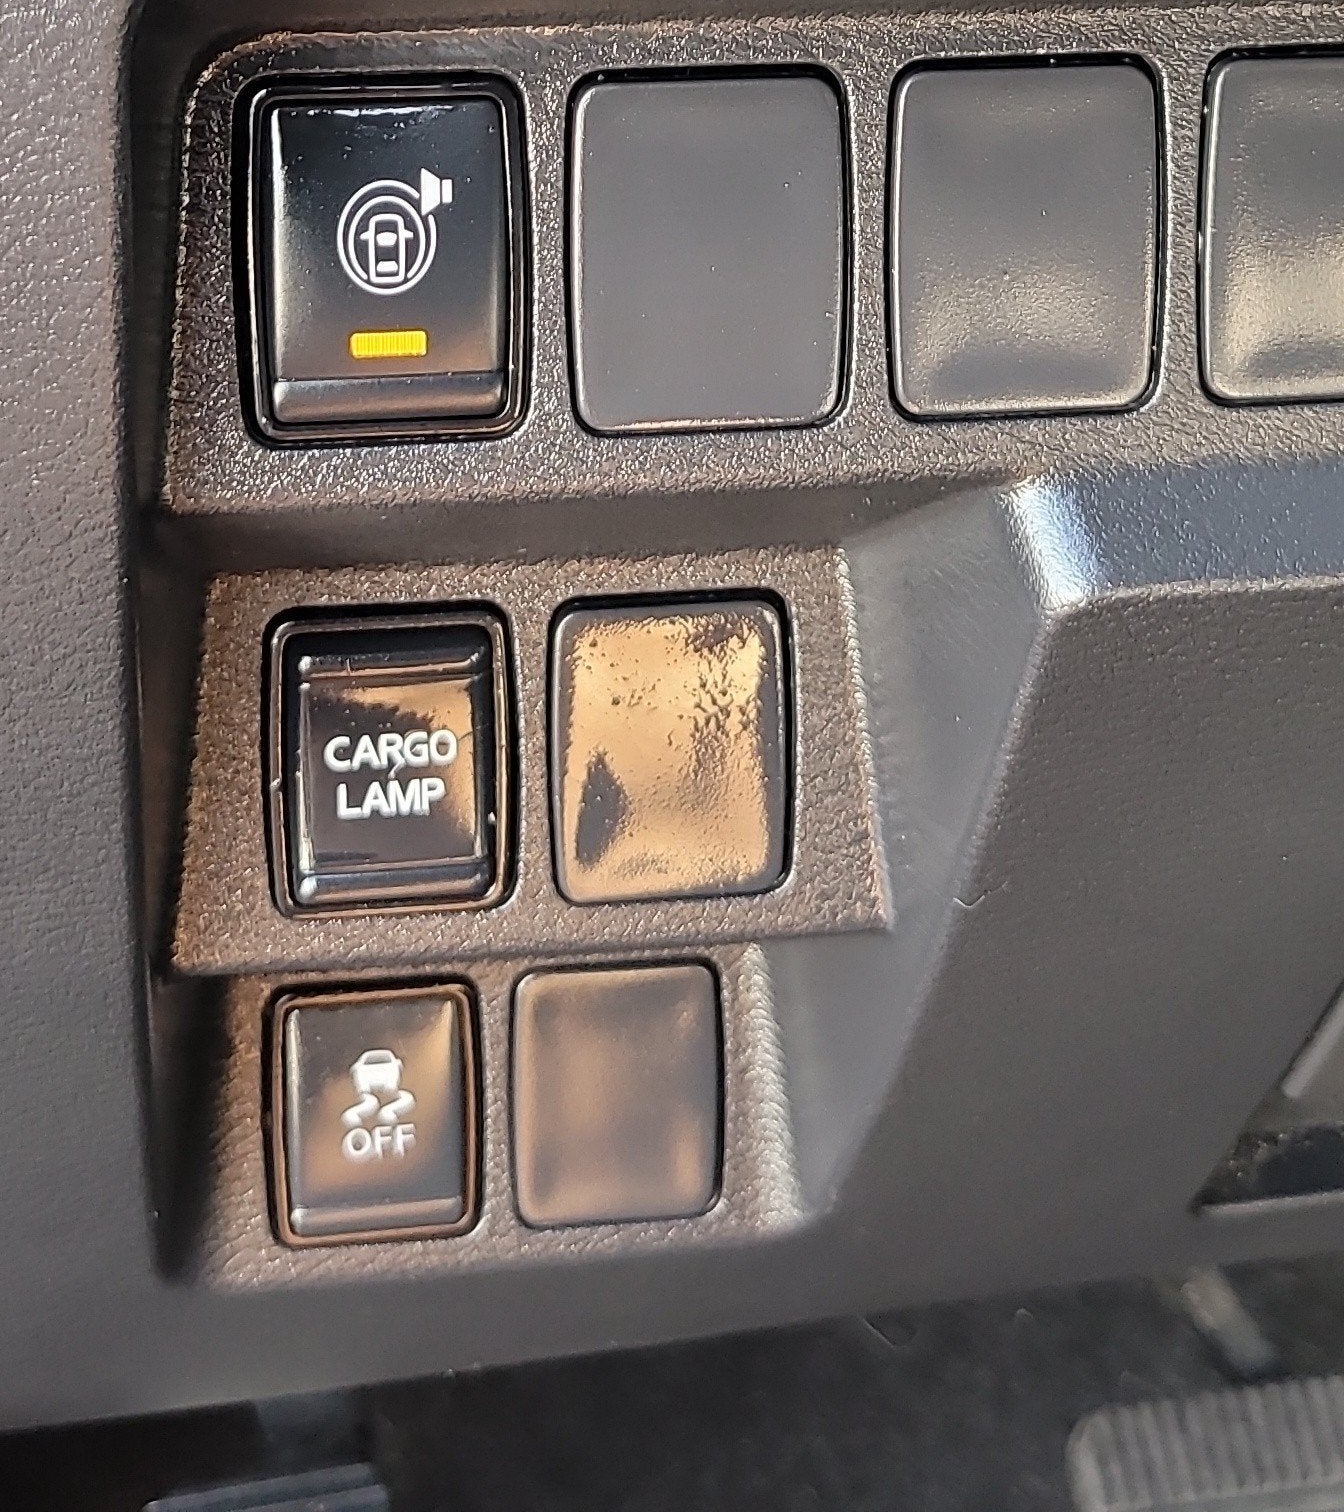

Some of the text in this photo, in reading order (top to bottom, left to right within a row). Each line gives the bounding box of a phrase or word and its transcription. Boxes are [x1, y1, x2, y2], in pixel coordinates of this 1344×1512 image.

[323, 728, 458, 773] CARGO
[335, 776, 446, 820] LAMP
[342, 1123, 416, 1163] OFF
